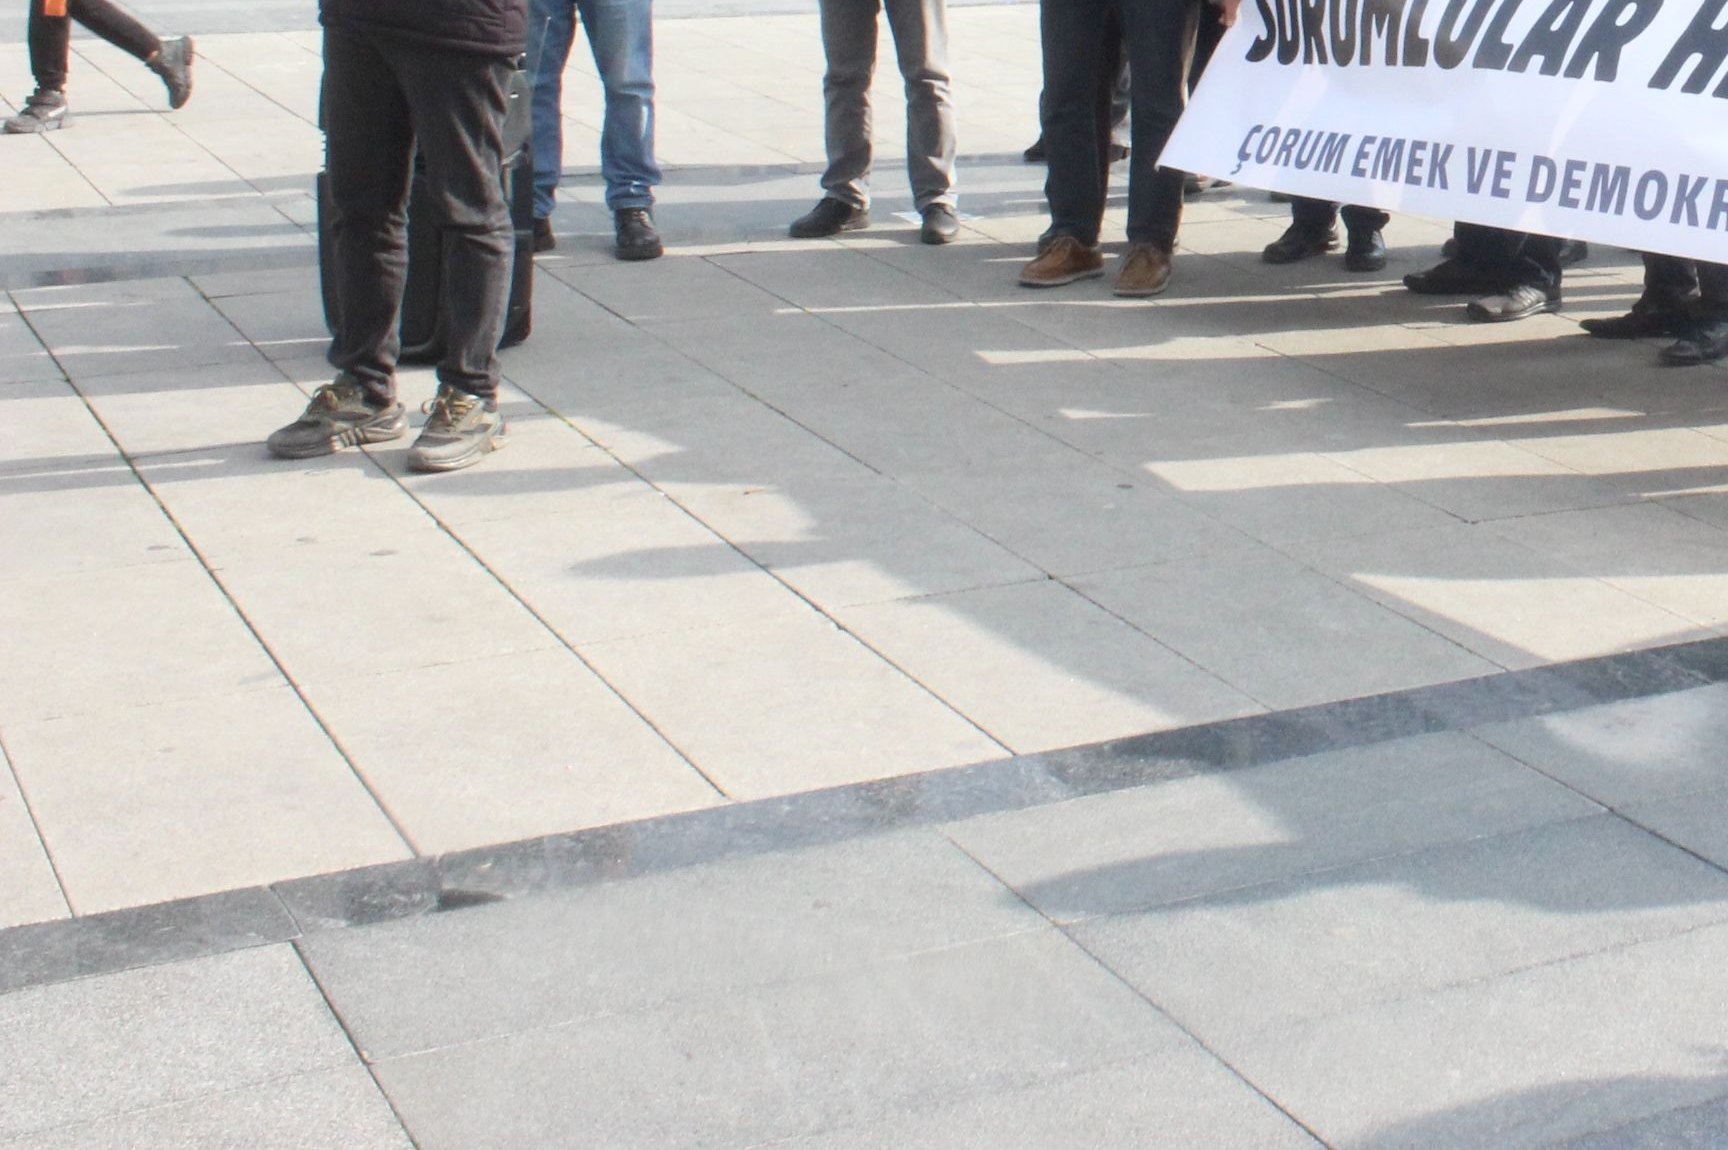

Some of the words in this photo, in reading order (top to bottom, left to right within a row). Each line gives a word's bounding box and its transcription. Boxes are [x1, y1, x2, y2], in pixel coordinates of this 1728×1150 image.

[1230, 124, 1352, 176] ÇORUM
[1350, 135, 1451, 190] EMEK
[1466, 146, 1518, 199] VE
